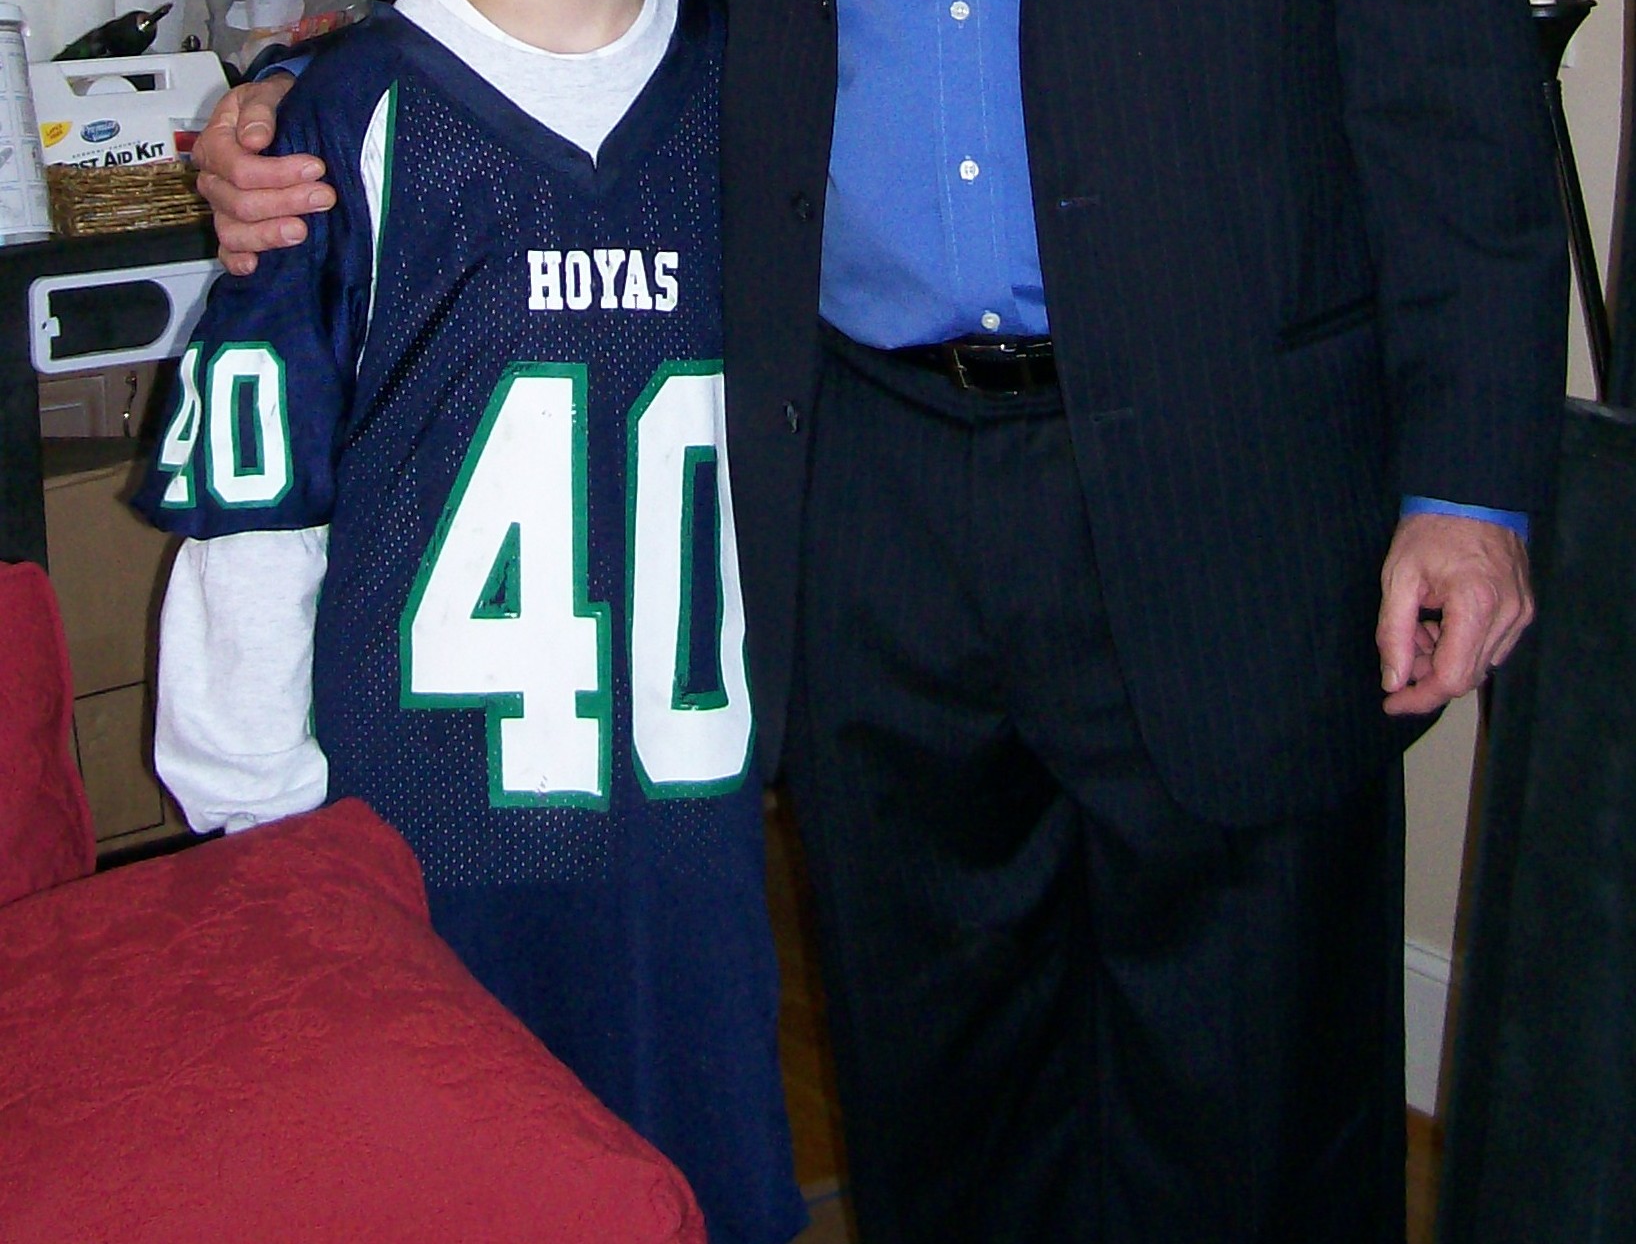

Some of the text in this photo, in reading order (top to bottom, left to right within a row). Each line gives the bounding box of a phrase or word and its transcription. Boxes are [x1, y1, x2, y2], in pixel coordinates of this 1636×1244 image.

[527, 249, 679, 312] HOYAS
[158, 341, 294, 510] 40
[399, 359, 756, 813] 40
